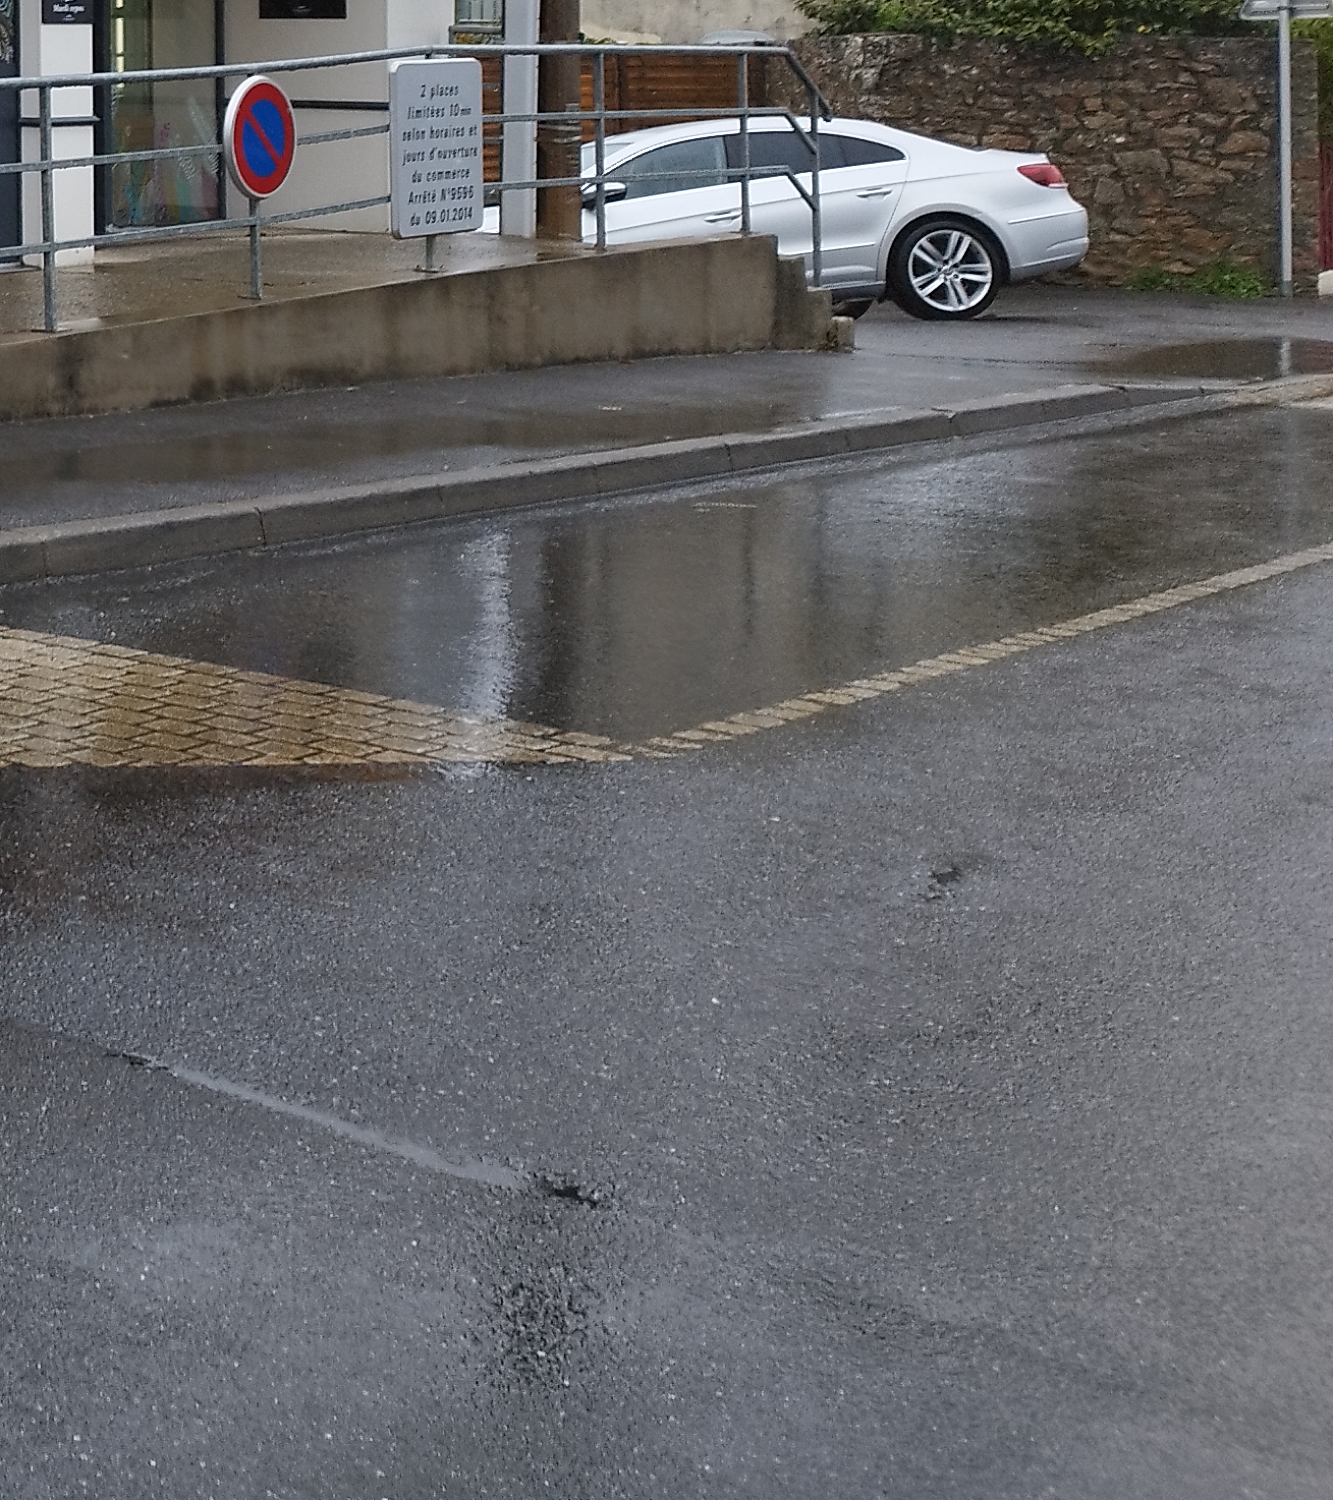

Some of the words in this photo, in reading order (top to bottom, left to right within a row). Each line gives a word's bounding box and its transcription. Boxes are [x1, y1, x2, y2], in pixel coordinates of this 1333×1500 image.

[420, 84, 426, 98] 2
[430, 84, 459, 100] places
[407, 106, 445, 120] limitées
[402, 127, 426, 142] selon
[430, 124, 465, 140] horaires
[468, 124, 478, 137] et
[402, 149, 426, 167] jours
[429, 146, 478, 162] d'ouverture
[411, 170, 422, 183] du
[426, 168, 470, 182] commerce
[408, 190, 436, 206] Arrêté
[410, 212, 421, 226] du
[425, 206, 473, 225] 09.01.2014
